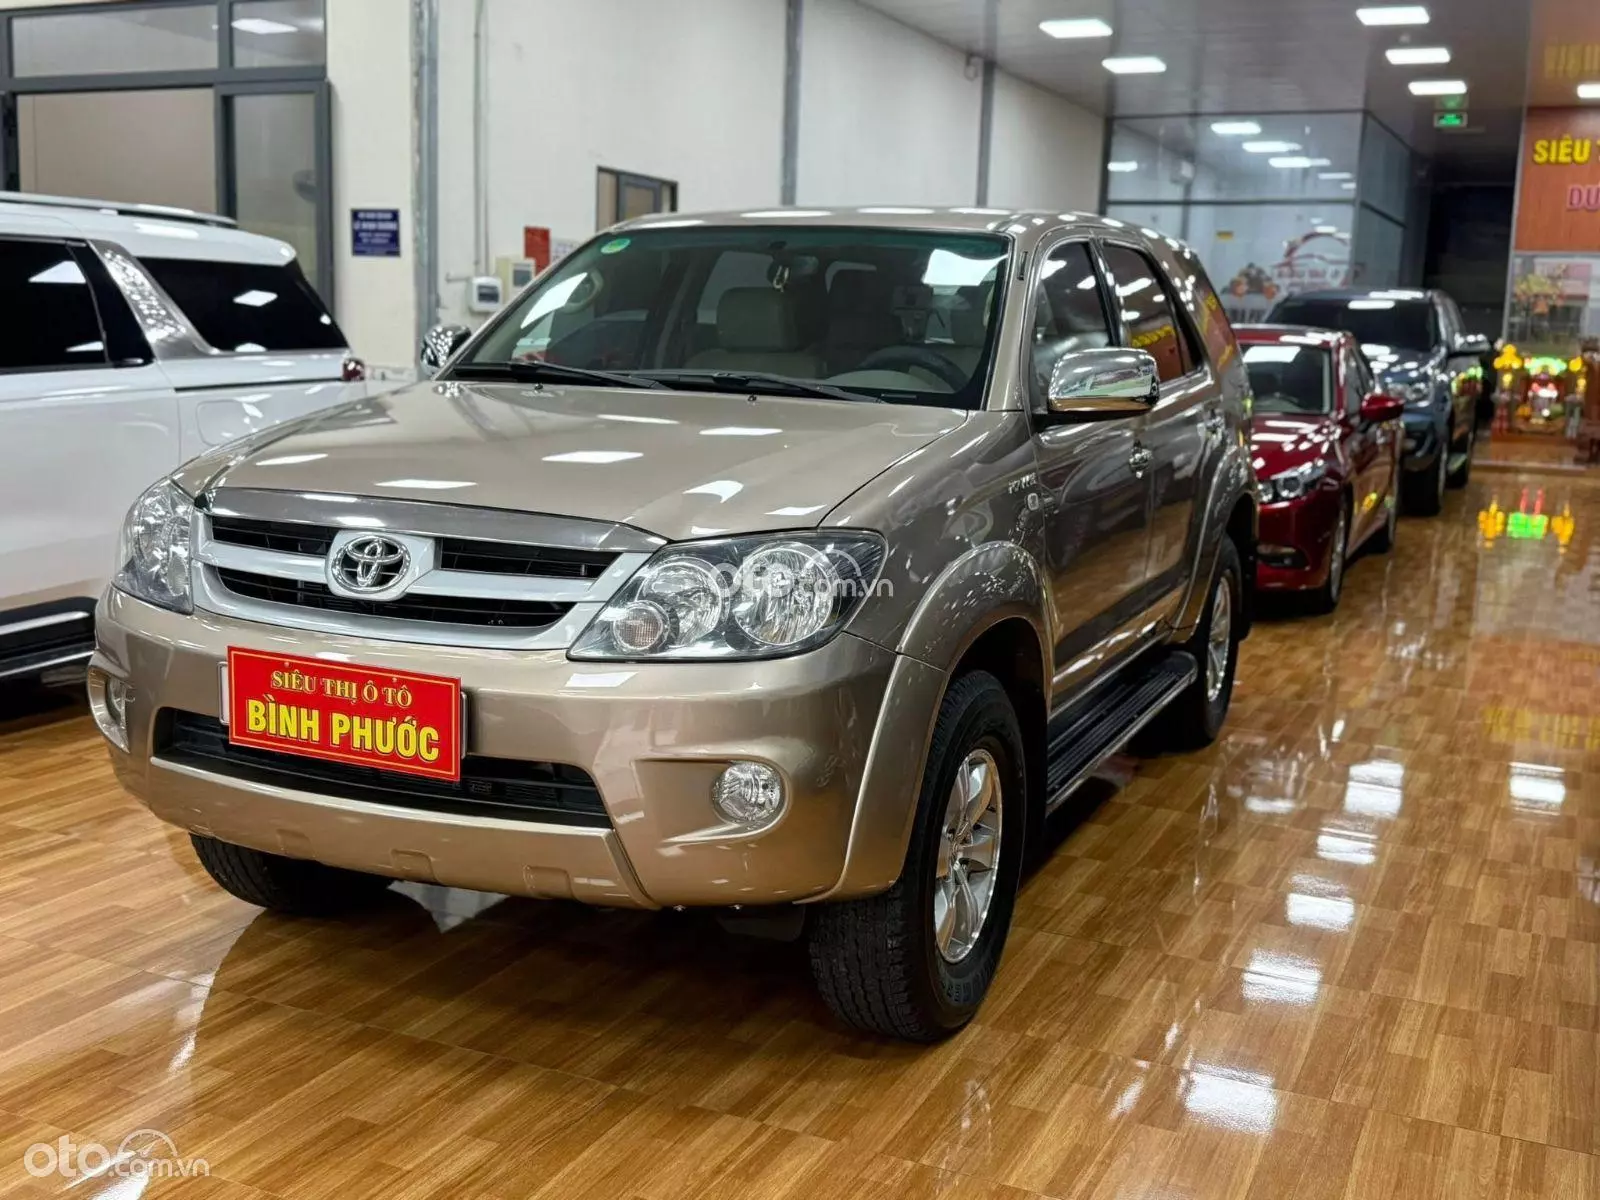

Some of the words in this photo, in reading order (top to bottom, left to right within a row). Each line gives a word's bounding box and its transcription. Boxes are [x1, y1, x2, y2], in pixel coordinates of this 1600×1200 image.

[1534, 134, 1591, 164] SIÊU
[271, 669, 317, 693] SIÊU
[321, 677, 357, 705] THỊ
[362, 680, 379, 703] Ô
[246, 694, 320, 743] BÌNH
[330, 711, 440, 762] PHƯỚC
